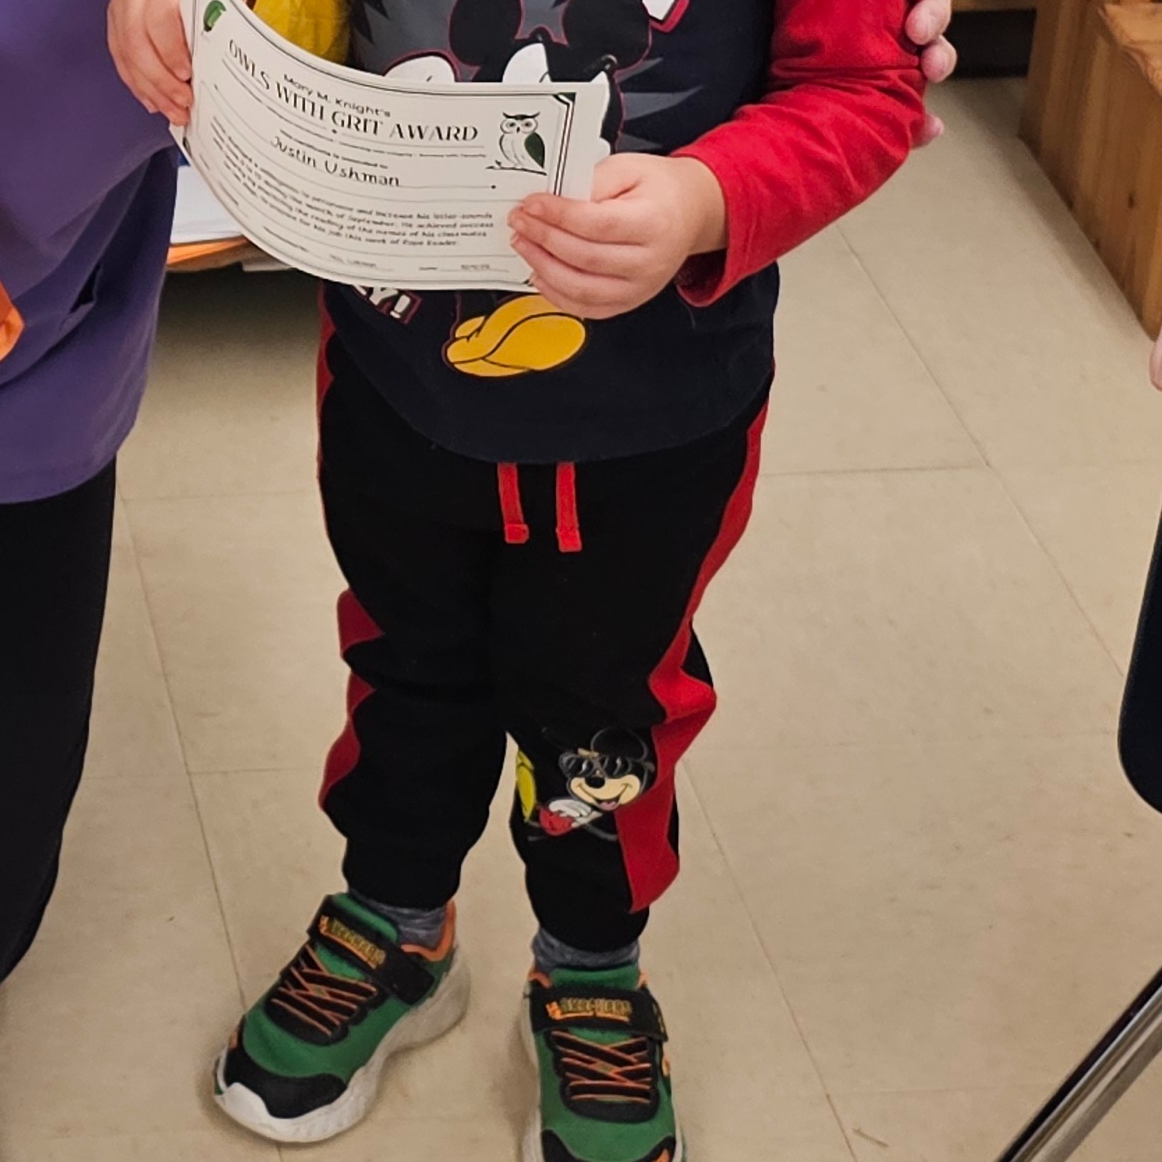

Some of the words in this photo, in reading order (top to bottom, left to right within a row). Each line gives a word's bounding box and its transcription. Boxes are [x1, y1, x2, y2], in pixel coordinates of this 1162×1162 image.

[229, 39, 270, 90] OWLS
[276, 81, 324, 121] WITH
[331, 110, 384, 136] GRIT
[389, 123, 479, 142] AWARD
[284, 74, 313, 97] Mary
[335, 97, 391, 118] Knight's
[270, 136, 317, 169] Justin
[324, 158, 401, 188] Ushman
